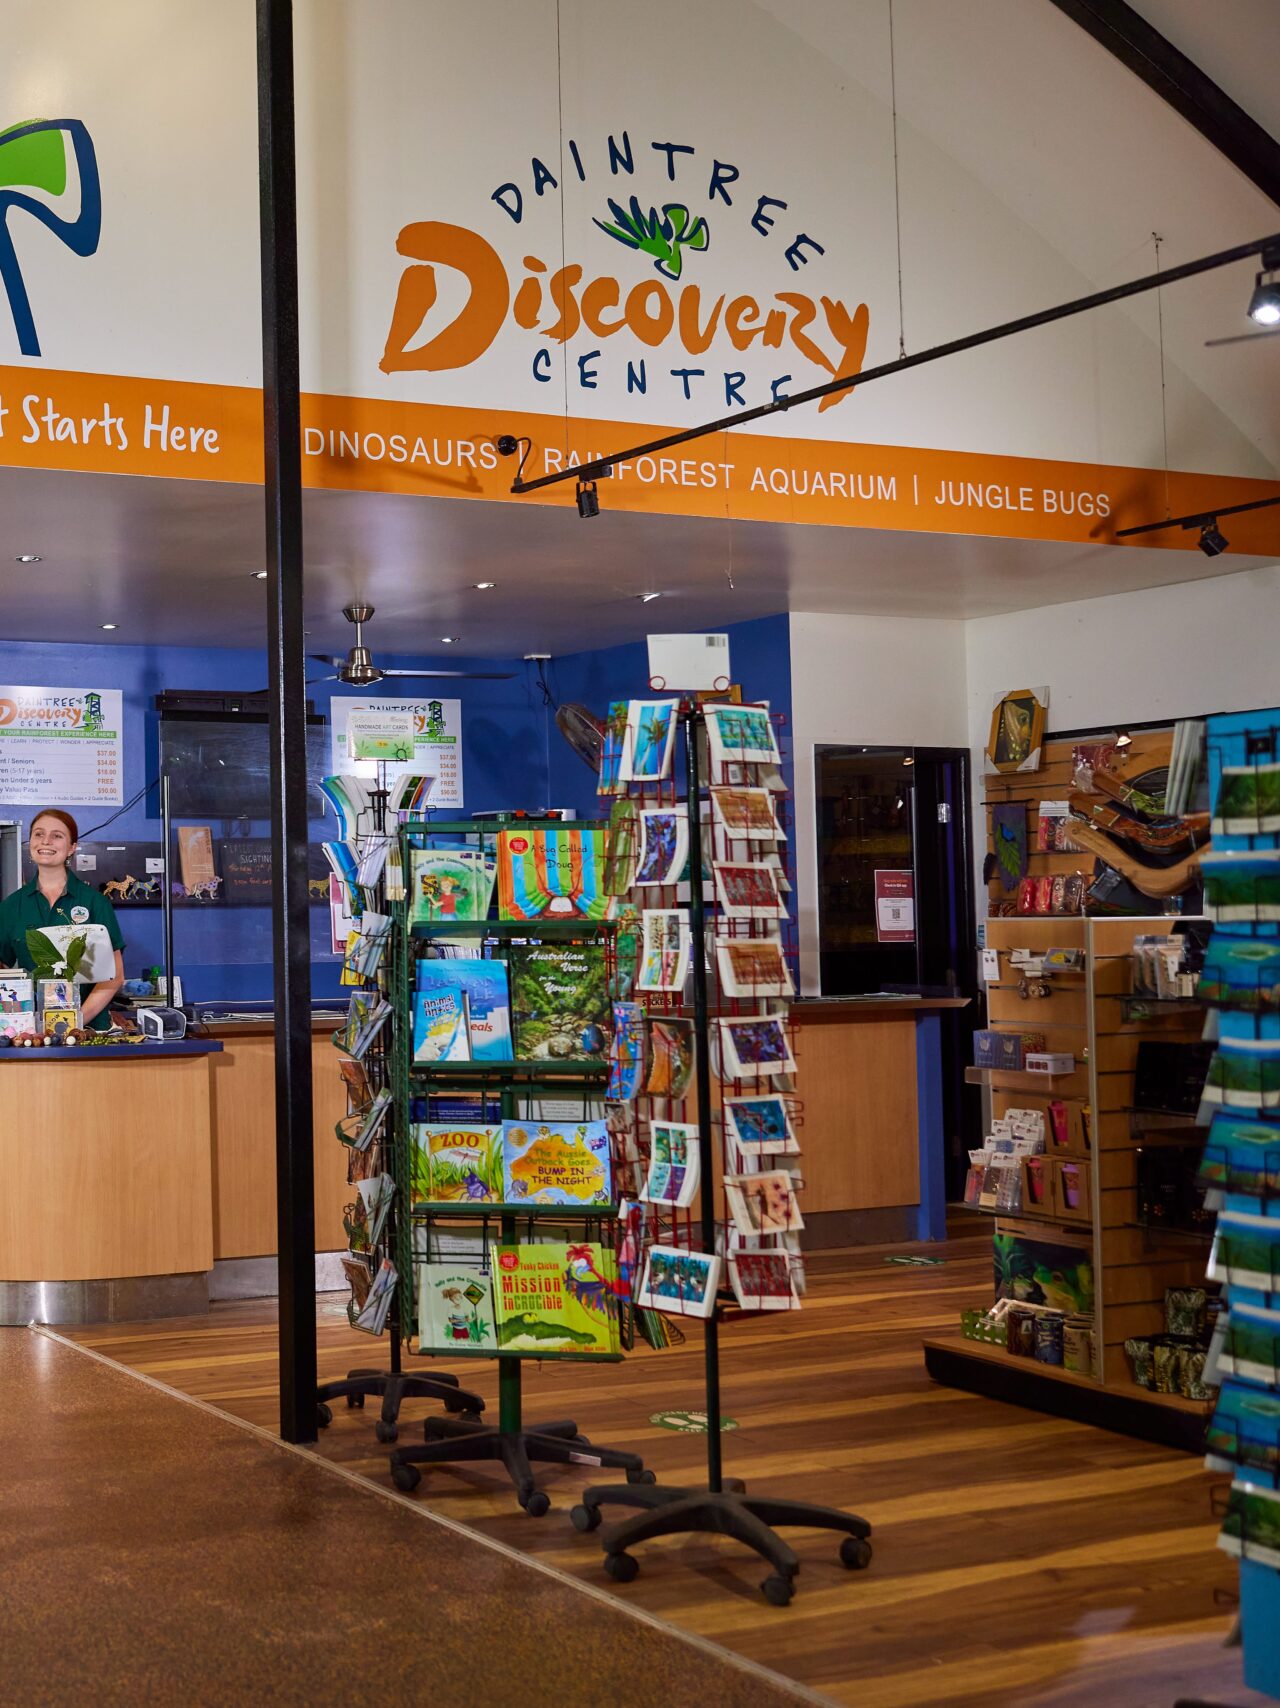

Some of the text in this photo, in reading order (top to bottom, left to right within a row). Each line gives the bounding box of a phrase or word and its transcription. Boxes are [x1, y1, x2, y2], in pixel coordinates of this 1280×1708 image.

[491, 131, 824, 271] DAINTREE
[378, 220, 869, 413] Discovery
[532, 350, 792, 411] CENTRE
[22, 395, 128, 451] Starts
[144, 405, 220, 453] Here
[304, 428, 498, 469] DINOSAURS
[751, 466, 896, 500] AQUARIUM
[935, 480, 1034, 511] JUNGLE
[1044, 491, 1110, 518] BUGS
[17, 697, 75, 706] DAINTREE
[540, 845, 556, 856] Bug
[559, 844, 587, 852] Called
[546, 859, 573, 872] Doug
[527, 951, 585, 960] Australian
[561, 962, 588, 972] Verse
[544, 982, 576, 994] Young
[471, 1023, 493, 1032] eals
[441, 1133, 479, 1148] ZOO
[538, 1166, 584, 1175] BUMP IN
[531, 1176, 592, 1185] THE NIGHT
[502, 1275, 561, 1293] Mission
[504, 1295, 562, 1310] InCROCible
